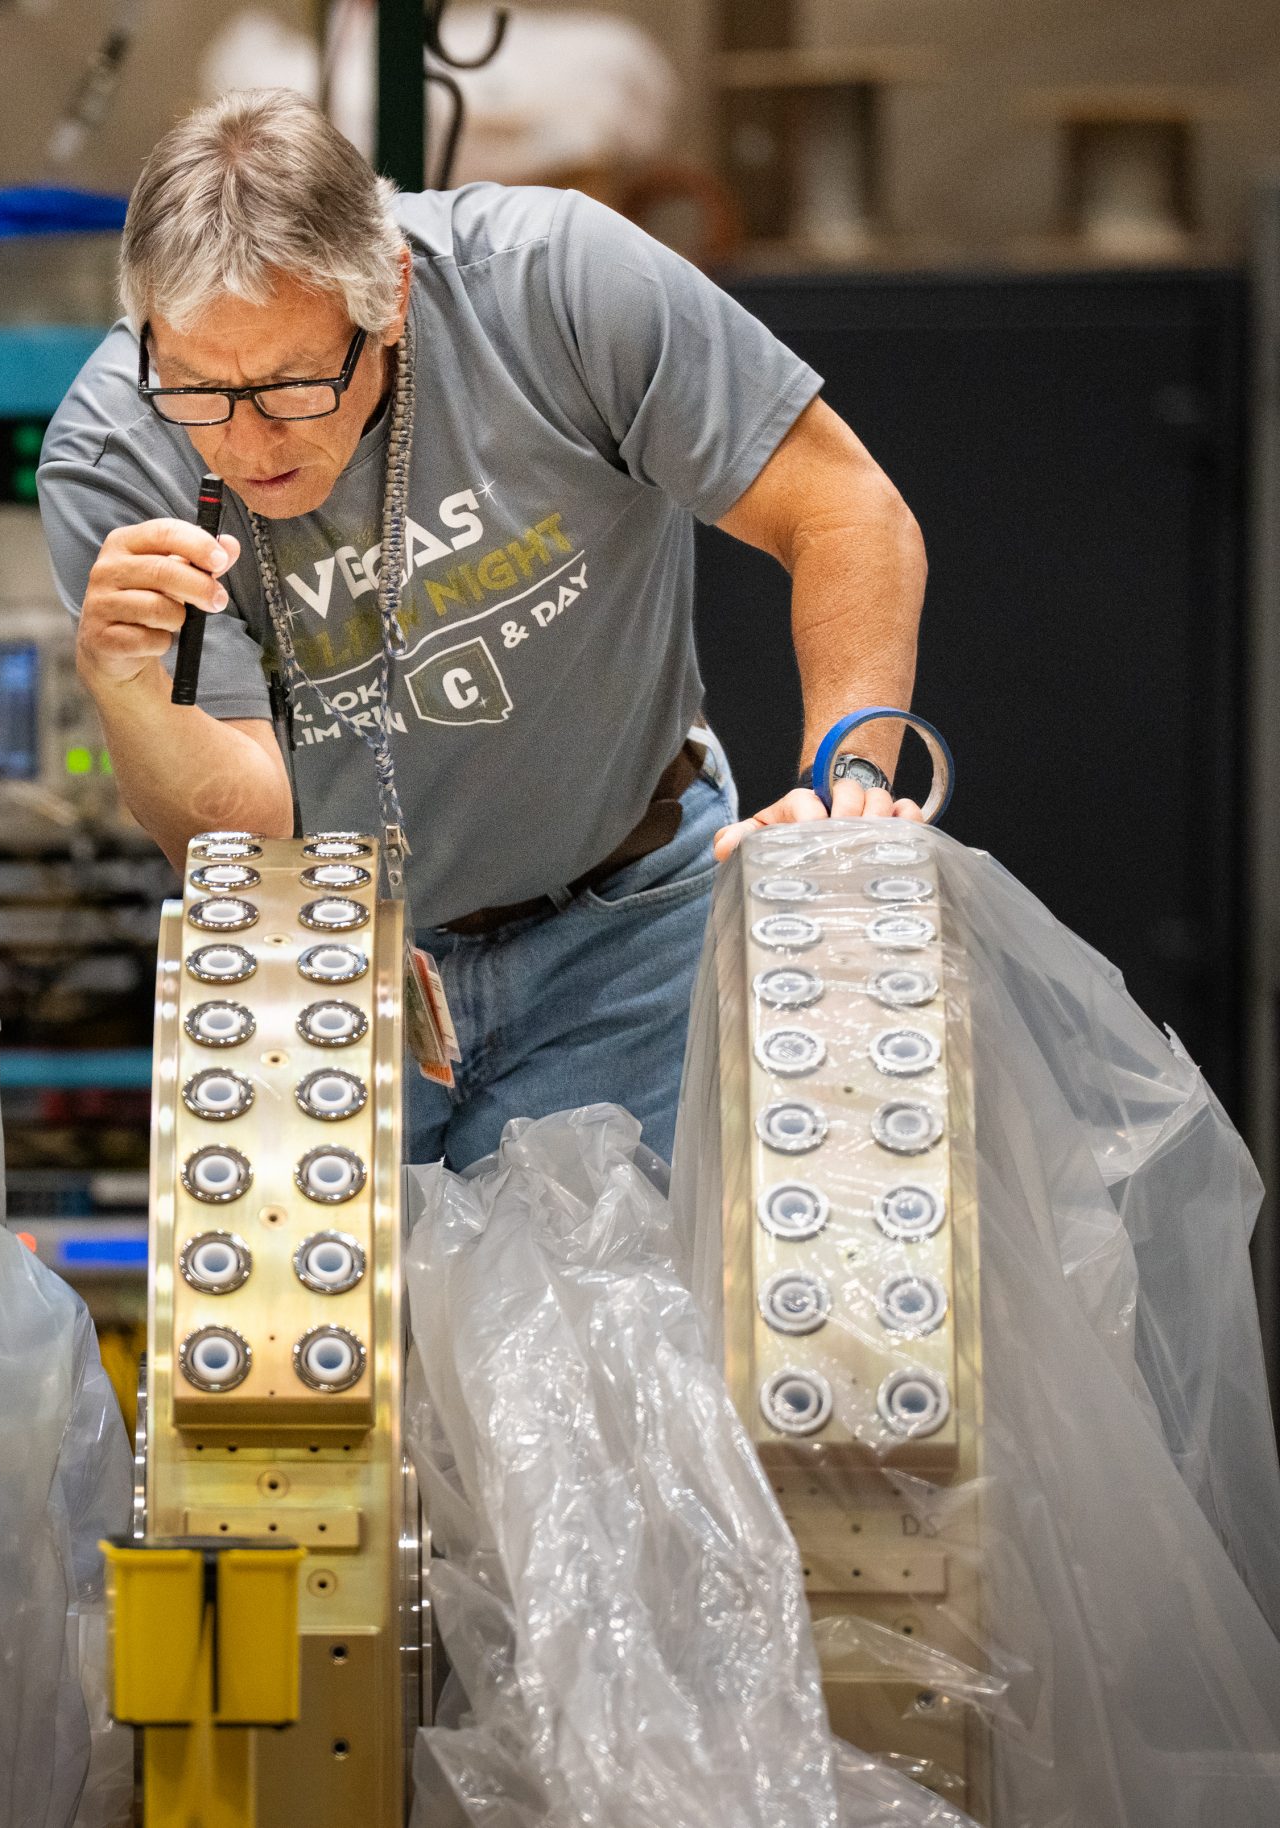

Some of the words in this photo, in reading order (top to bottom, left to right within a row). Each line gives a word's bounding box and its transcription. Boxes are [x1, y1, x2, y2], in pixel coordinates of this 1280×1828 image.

[423, 511, 574, 617] NIGHT
[500, 620, 529, 649] &
[530, 562, 588, 628] DAY
[442, 667, 480, 710] C
